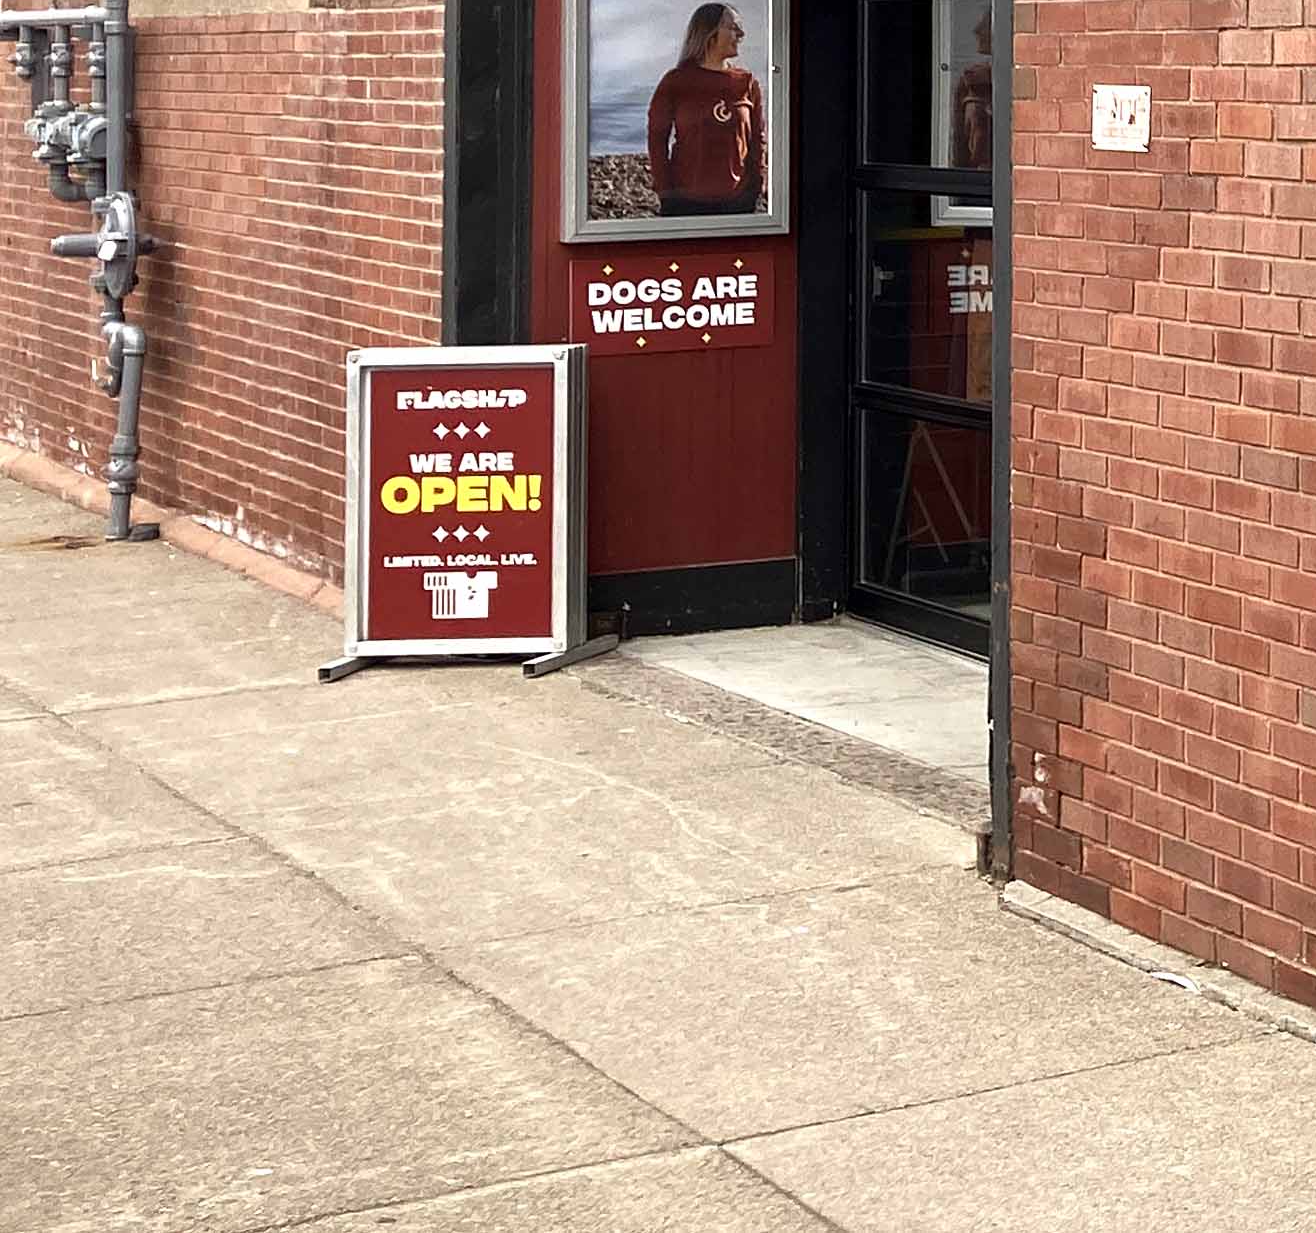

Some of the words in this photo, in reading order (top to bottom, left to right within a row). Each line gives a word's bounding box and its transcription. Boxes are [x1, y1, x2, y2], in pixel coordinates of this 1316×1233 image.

[588, 278, 683, 306] DOGS
[691, 274, 758, 300] ARE
[591, 302, 755, 334] WELCOME
[397, 389, 527, 410] FLAGSHIP
[409, 453, 452, 473] WE
[459, 452, 514, 472] ARE
[380, 474, 542, 515] OPEN!
[383, 555, 445, 568] LIMITED.
[447, 554, 498, 567] LOCAL.
[501, 553, 537, 566] LIVE.
